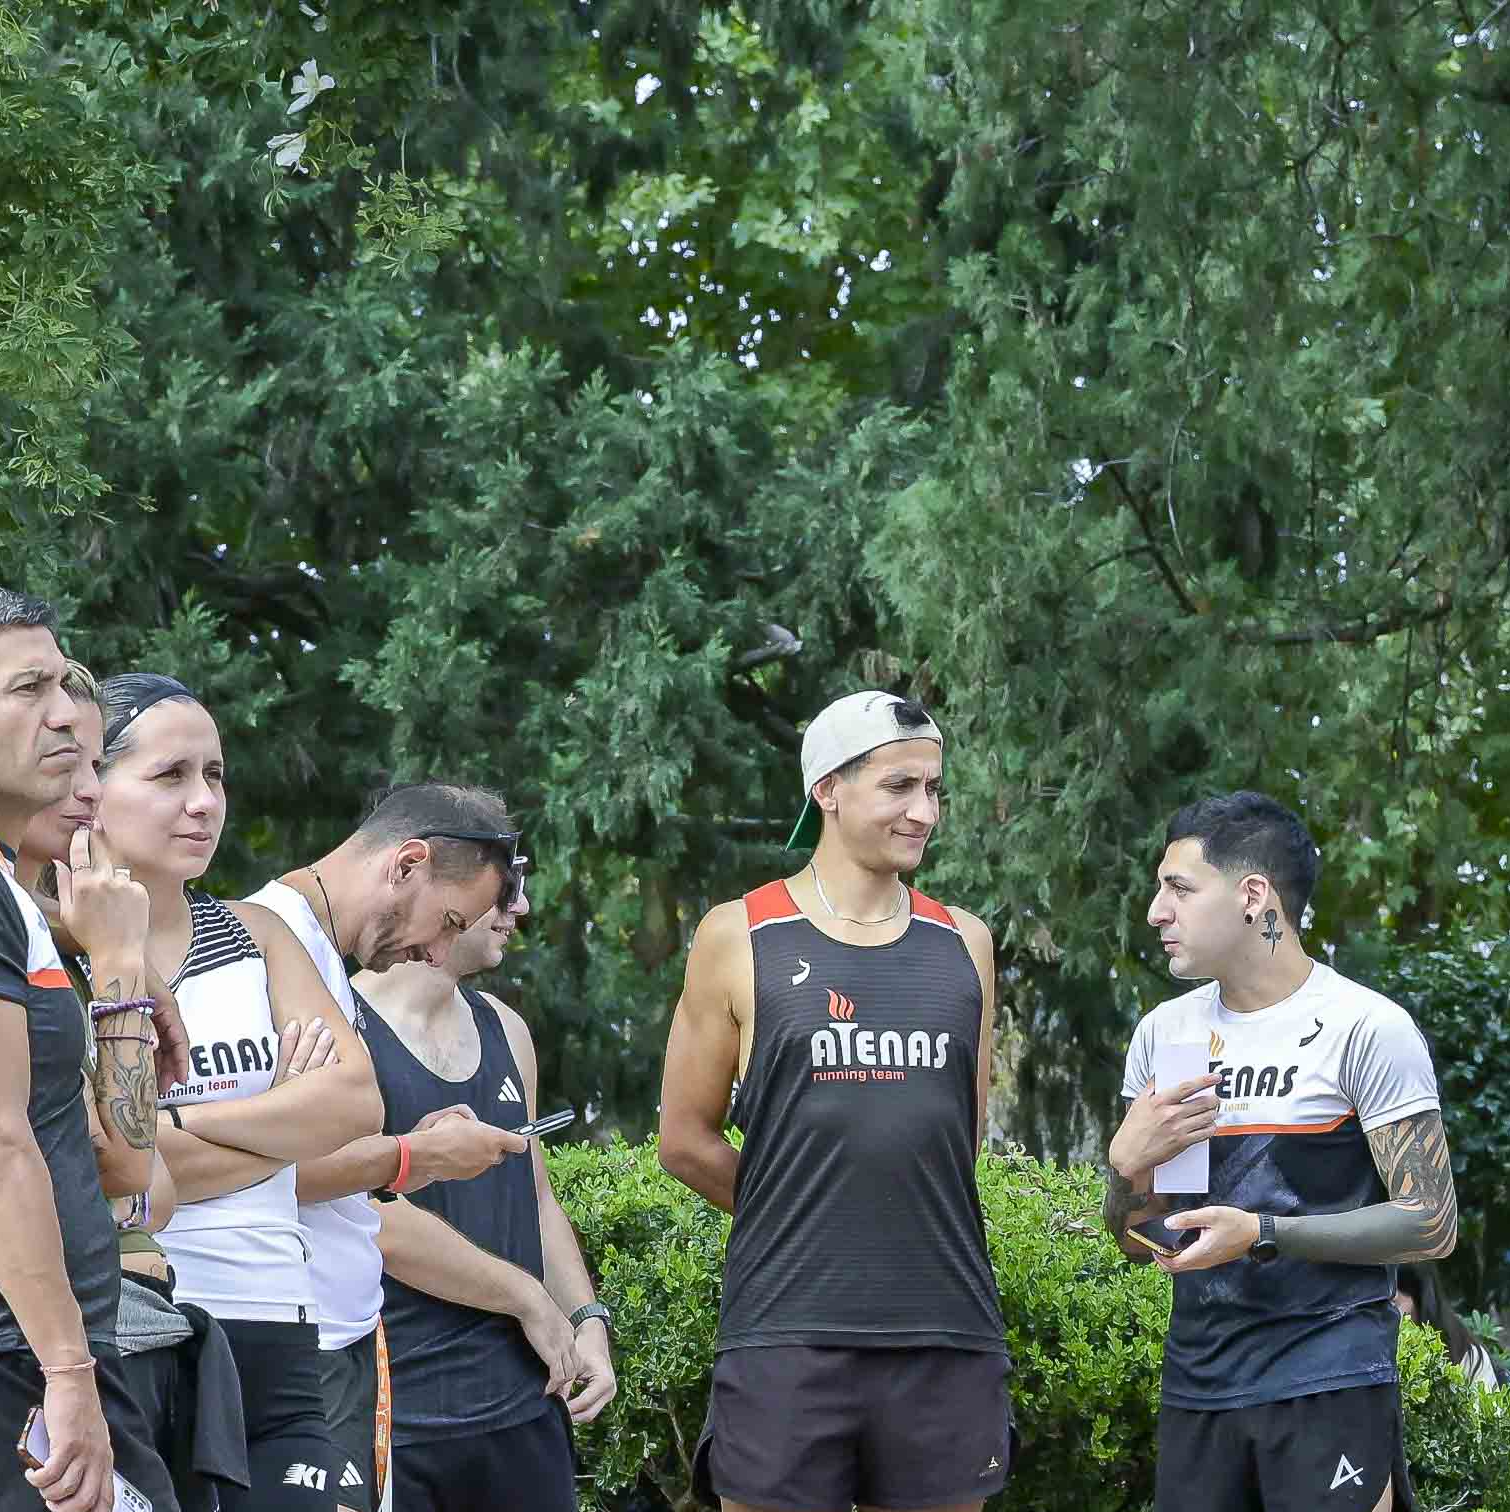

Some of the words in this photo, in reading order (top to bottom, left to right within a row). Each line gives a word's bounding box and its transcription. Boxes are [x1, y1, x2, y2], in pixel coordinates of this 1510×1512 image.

[190, 1036, 274, 1077] ENAS
[811, 1022, 951, 1069] ATENAS
[158, 1084, 204, 1099] unning
[208, 1079, 239, 1092] team
[813, 1068, 867, 1083] running
[871, 1067, 906, 1081] team
[1209, 1061, 1299, 1100] ENAS
